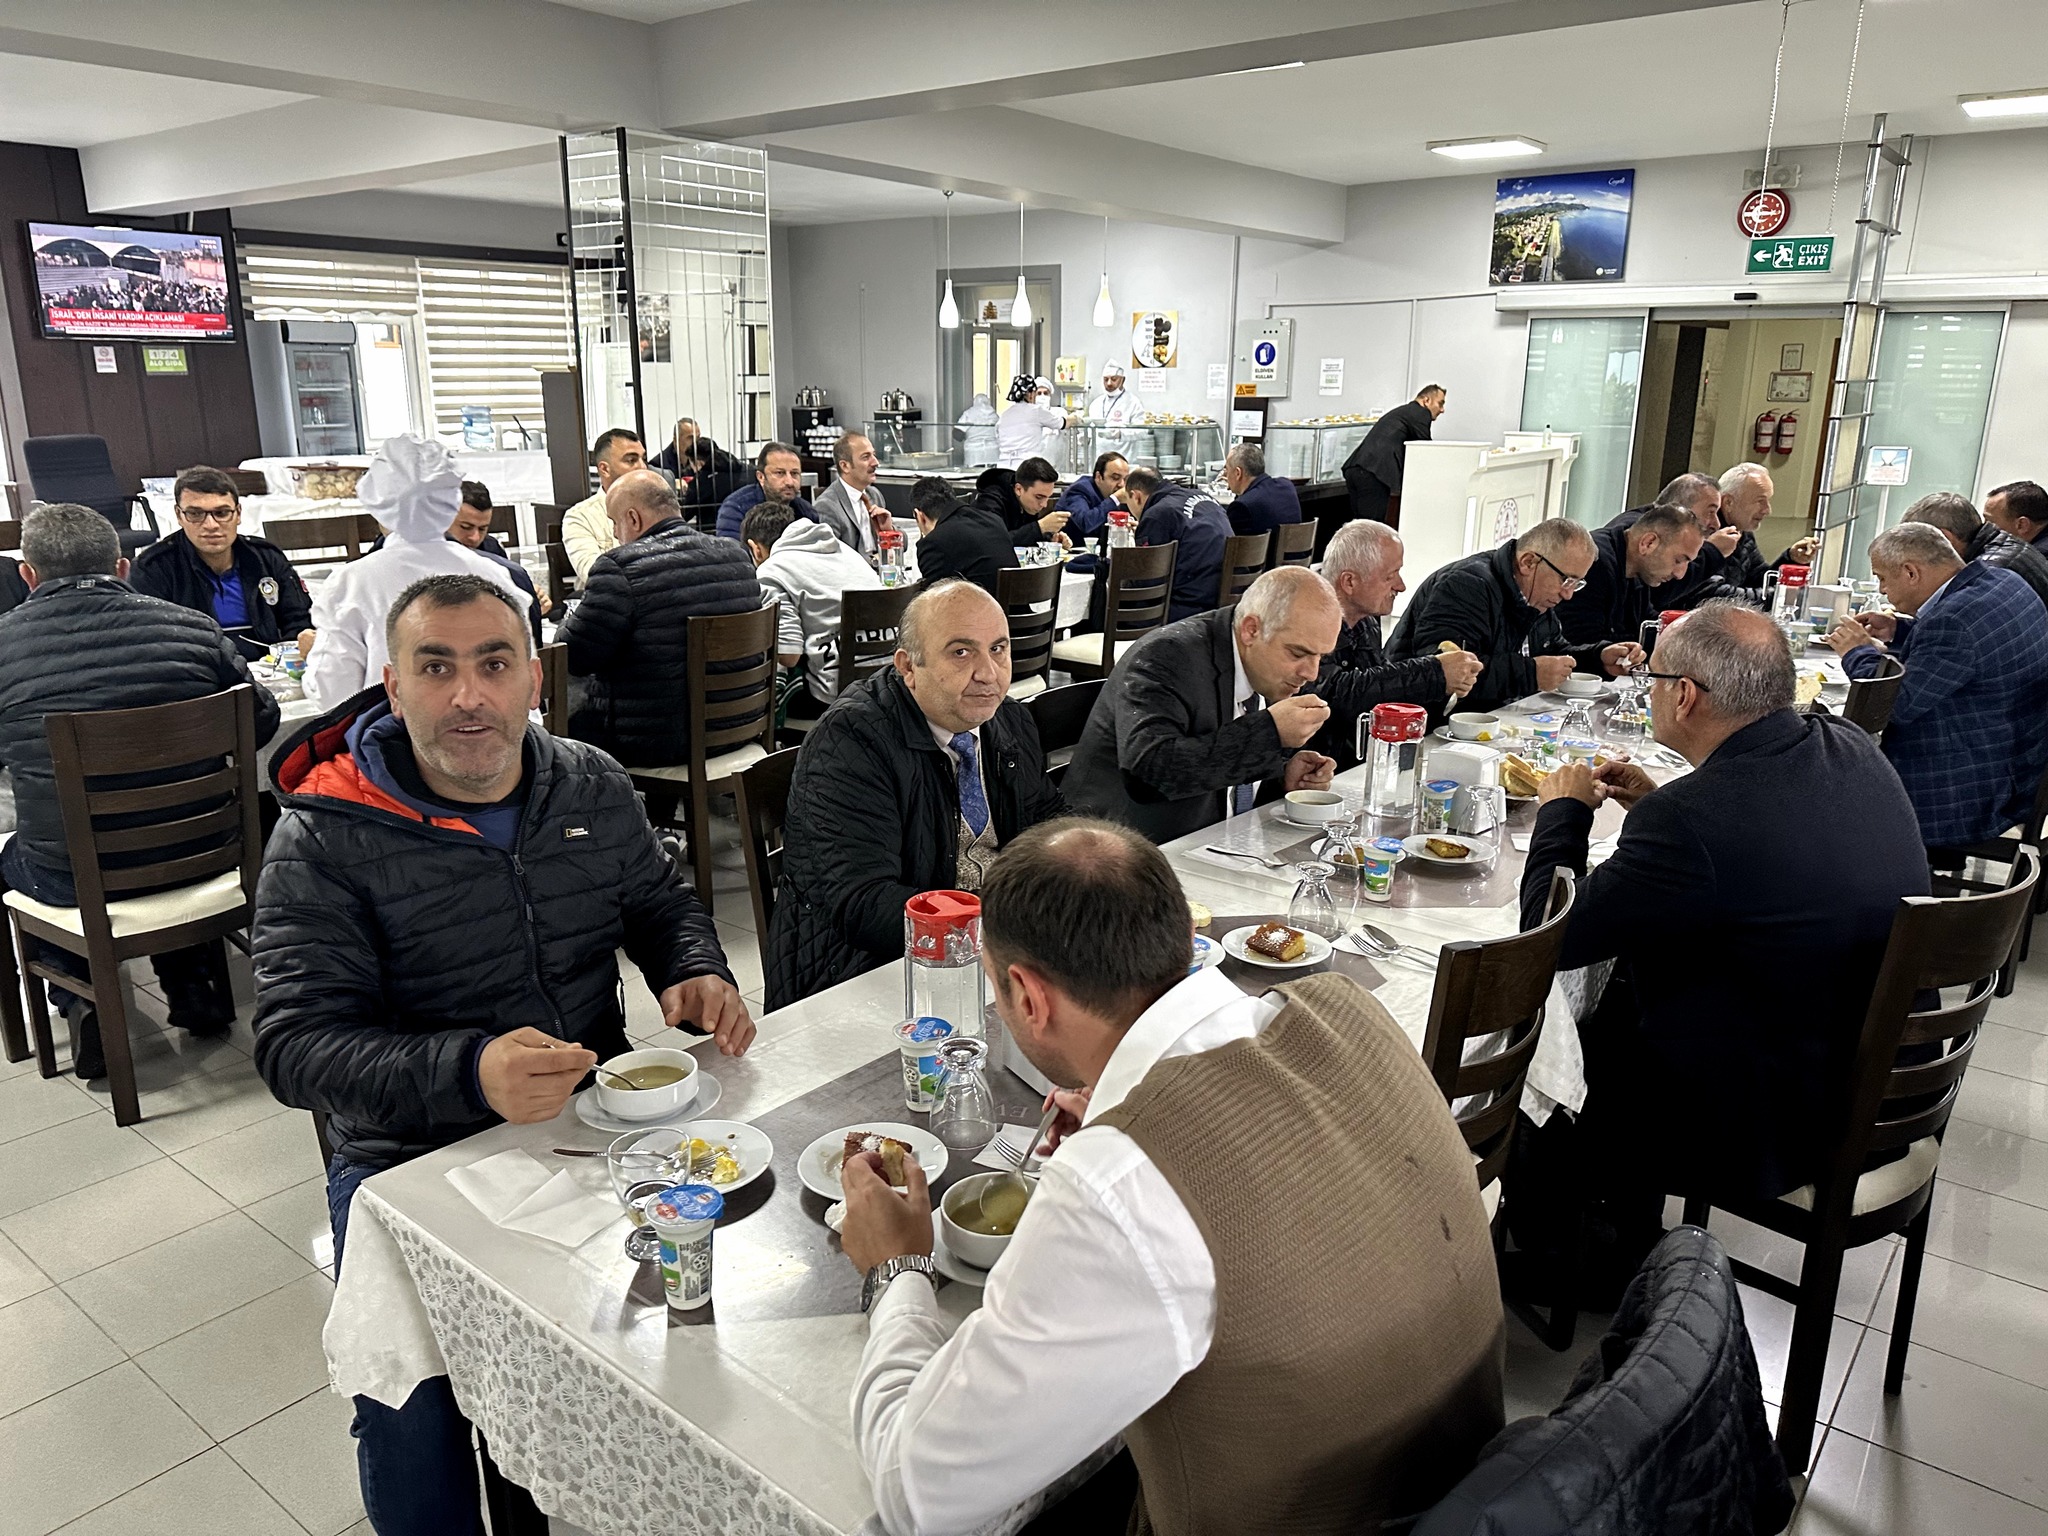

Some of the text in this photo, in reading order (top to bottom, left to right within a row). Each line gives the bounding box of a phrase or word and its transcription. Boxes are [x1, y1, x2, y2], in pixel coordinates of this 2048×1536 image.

[1799, 244, 1829, 255] ÇIKIŞ
[1797, 255, 1827, 266] EXIT
[51, 308, 185, 324] İSRAİL'DEN İNSANİ YARDIM AÇIKLAMASI
